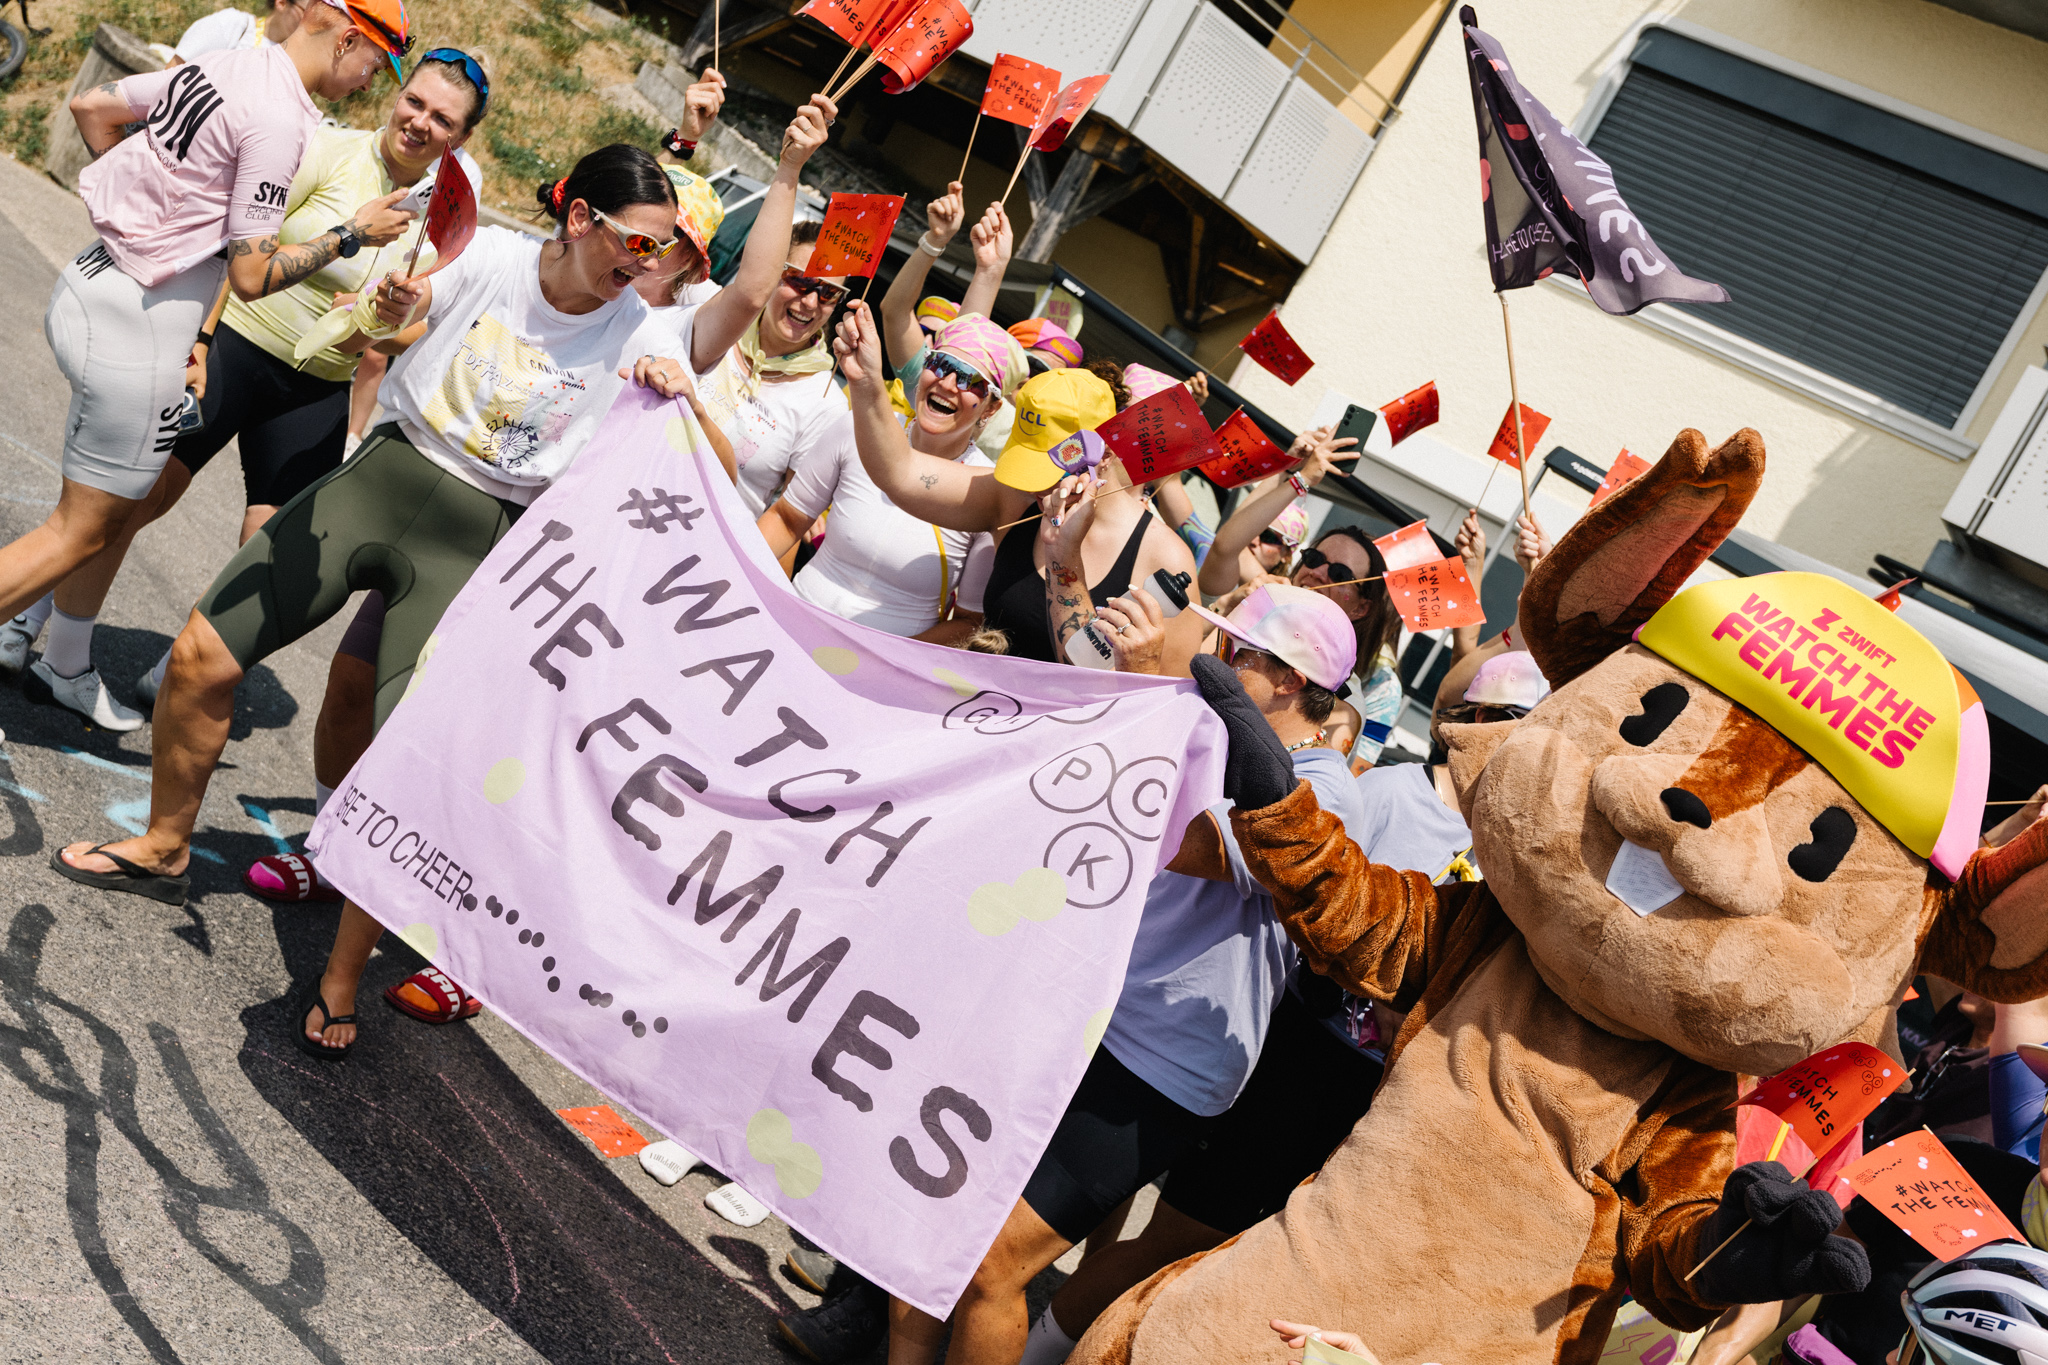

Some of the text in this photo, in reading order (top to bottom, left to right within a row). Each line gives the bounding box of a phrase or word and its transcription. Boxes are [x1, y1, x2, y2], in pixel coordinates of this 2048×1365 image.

[918, 17, 935, 40] THE
[993, 79, 1012, 95] THE
[1003, 75, 1043, 105] #WATCH
[148, 65, 224, 162] SYN
[254, 181, 289, 208] SYN
[245, 212, 270, 221] CLUB
[835, 221, 869, 244] #WATCH
[76, 244, 115, 280] SYN
[824, 230, 840, 244] THE
[840, 241, 872, 263] FEMMES
[529, 359, 575, 380] CANYON
[153, 402, 184, 453] SYN
[503, 418, 539, 444] ALLEZ
[1020, 407, 1046, 427] LCL
[1152, 407, 1168, 453] #WATCH
[1137, 404, 1154, 474] THE FEMMES
[1220, 436, 1235, 460] THE
[1232, 439, 1262, 477] #WATC
[1418, 565, 1428, 585] HE
[1429, 566, 1441, 617] #WATCH
[1837, 625, 1897, 669] ZWIFT
[1739, 592, 1937, 747] WATCH THE
[617, 487, 932, 888] #WATCH
[1711, 611, 1905, 769] FEMMES
[356, 802, 399, 848] TO
[389, 831, 473, 911] CHEER
[499, 519, 992, 1198] THE FEMMES
[1891, 1196, 1937, 1215] THE
[1943, 1309, 2017, 1333] MET
